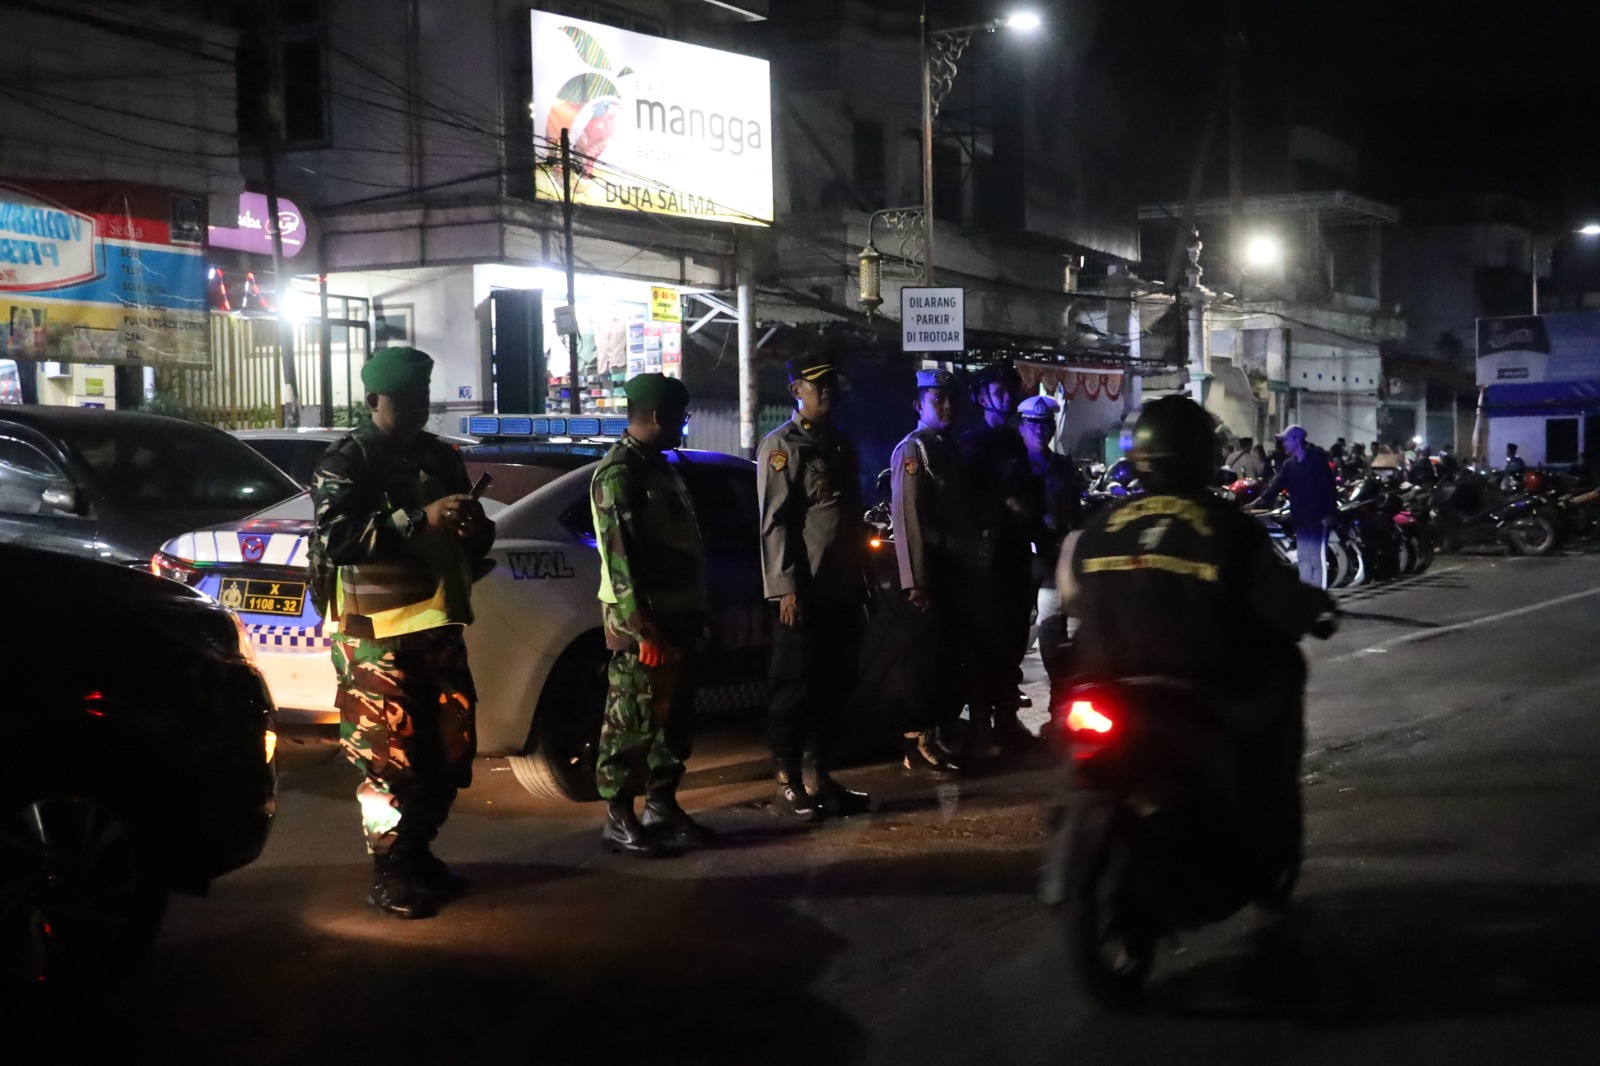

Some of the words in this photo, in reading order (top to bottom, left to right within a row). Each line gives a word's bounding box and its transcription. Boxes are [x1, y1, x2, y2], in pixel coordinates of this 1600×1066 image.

[635, 98, 762, 156] mangga
[606, 181, 653, 208] DUTA
[658, 189, 716, 215] SALMA
[109, 220, 143, 239] Sedia
[909, 296, 956, 308] DILARANG
[916, 314, 950, 325] PARKIR
[906, 331, 916, 343] DI
[918, 331, 960, 343] TROTOAR
[507, 552, 575, 580] WAL
[270, 584, 280, 595] X
[249, 597, 274, 610] 1108
[282, 599, 297, 612] 32
